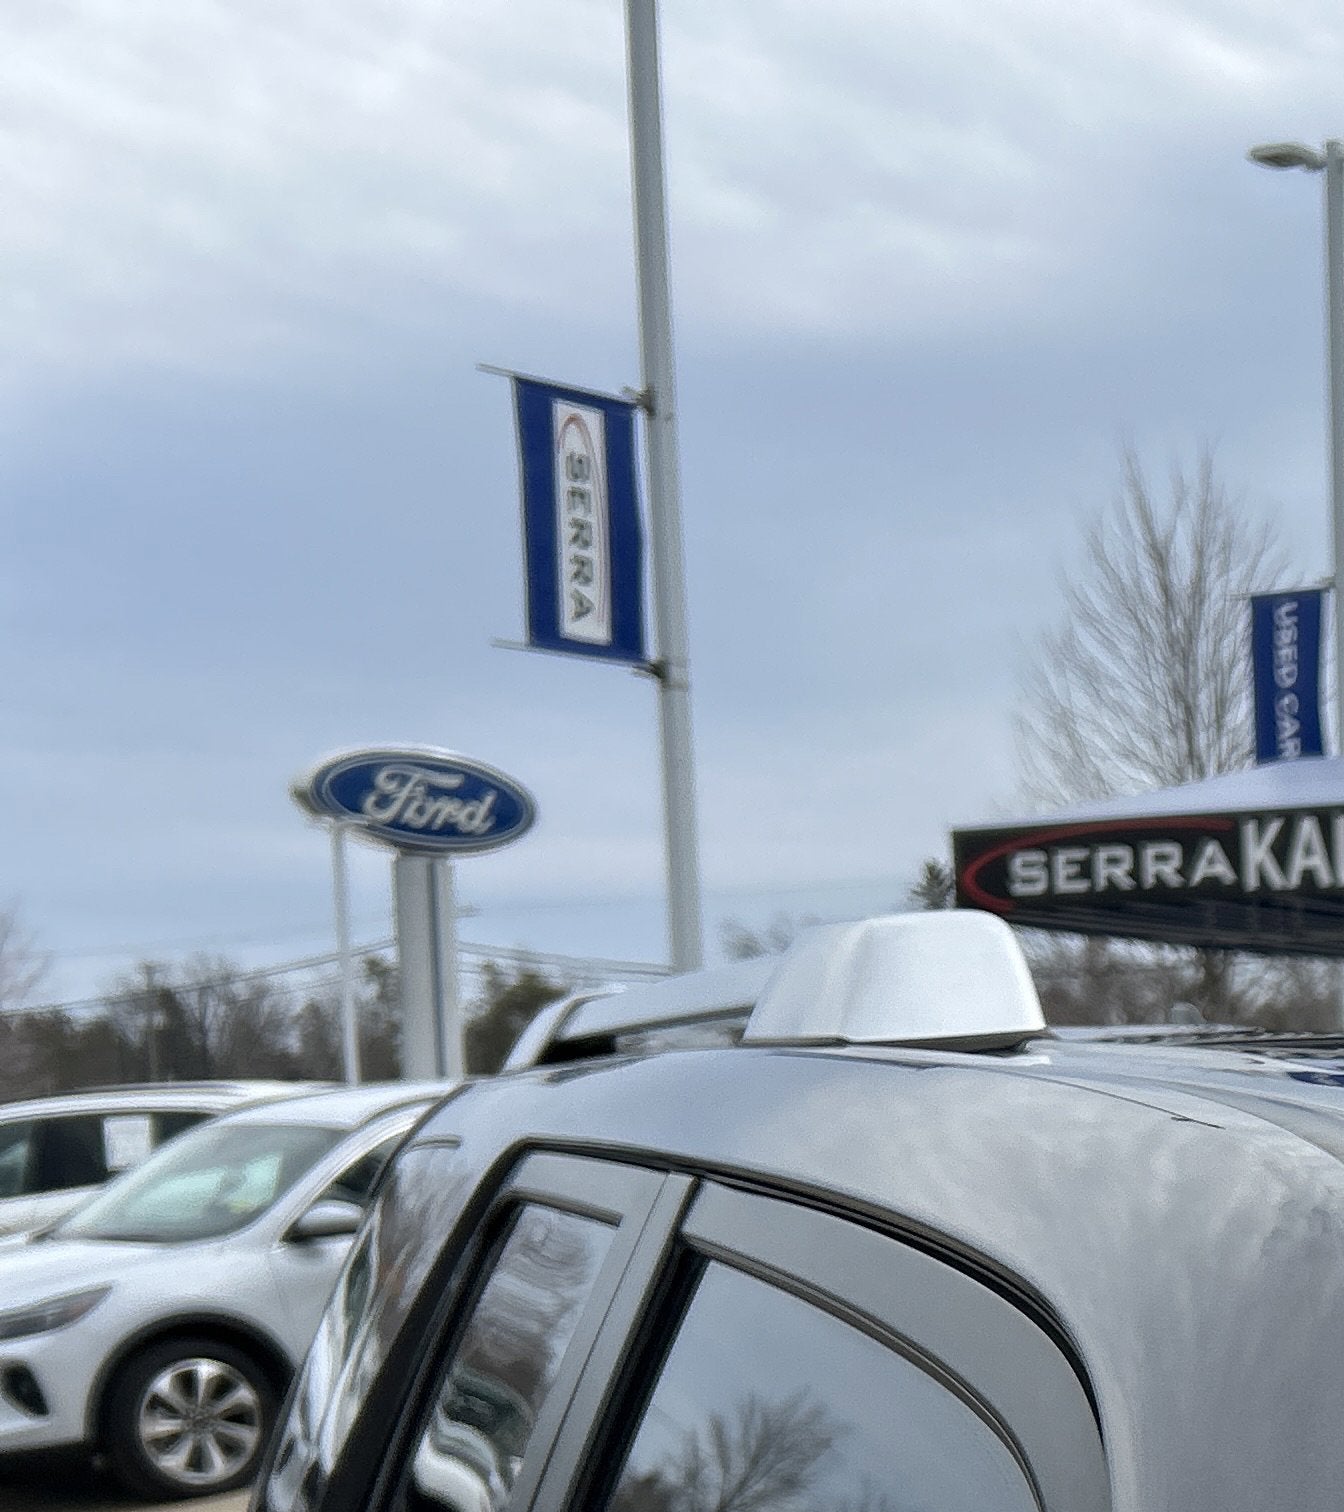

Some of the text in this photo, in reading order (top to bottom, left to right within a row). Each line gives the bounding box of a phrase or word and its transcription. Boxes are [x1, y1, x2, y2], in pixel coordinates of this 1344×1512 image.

[564, 449, 595, 623] SERRA
[1273, 602, 1299, 689] USED
[363, 764, 498, 835] Ford
[1007, 837, 1237, 897] SERRA
